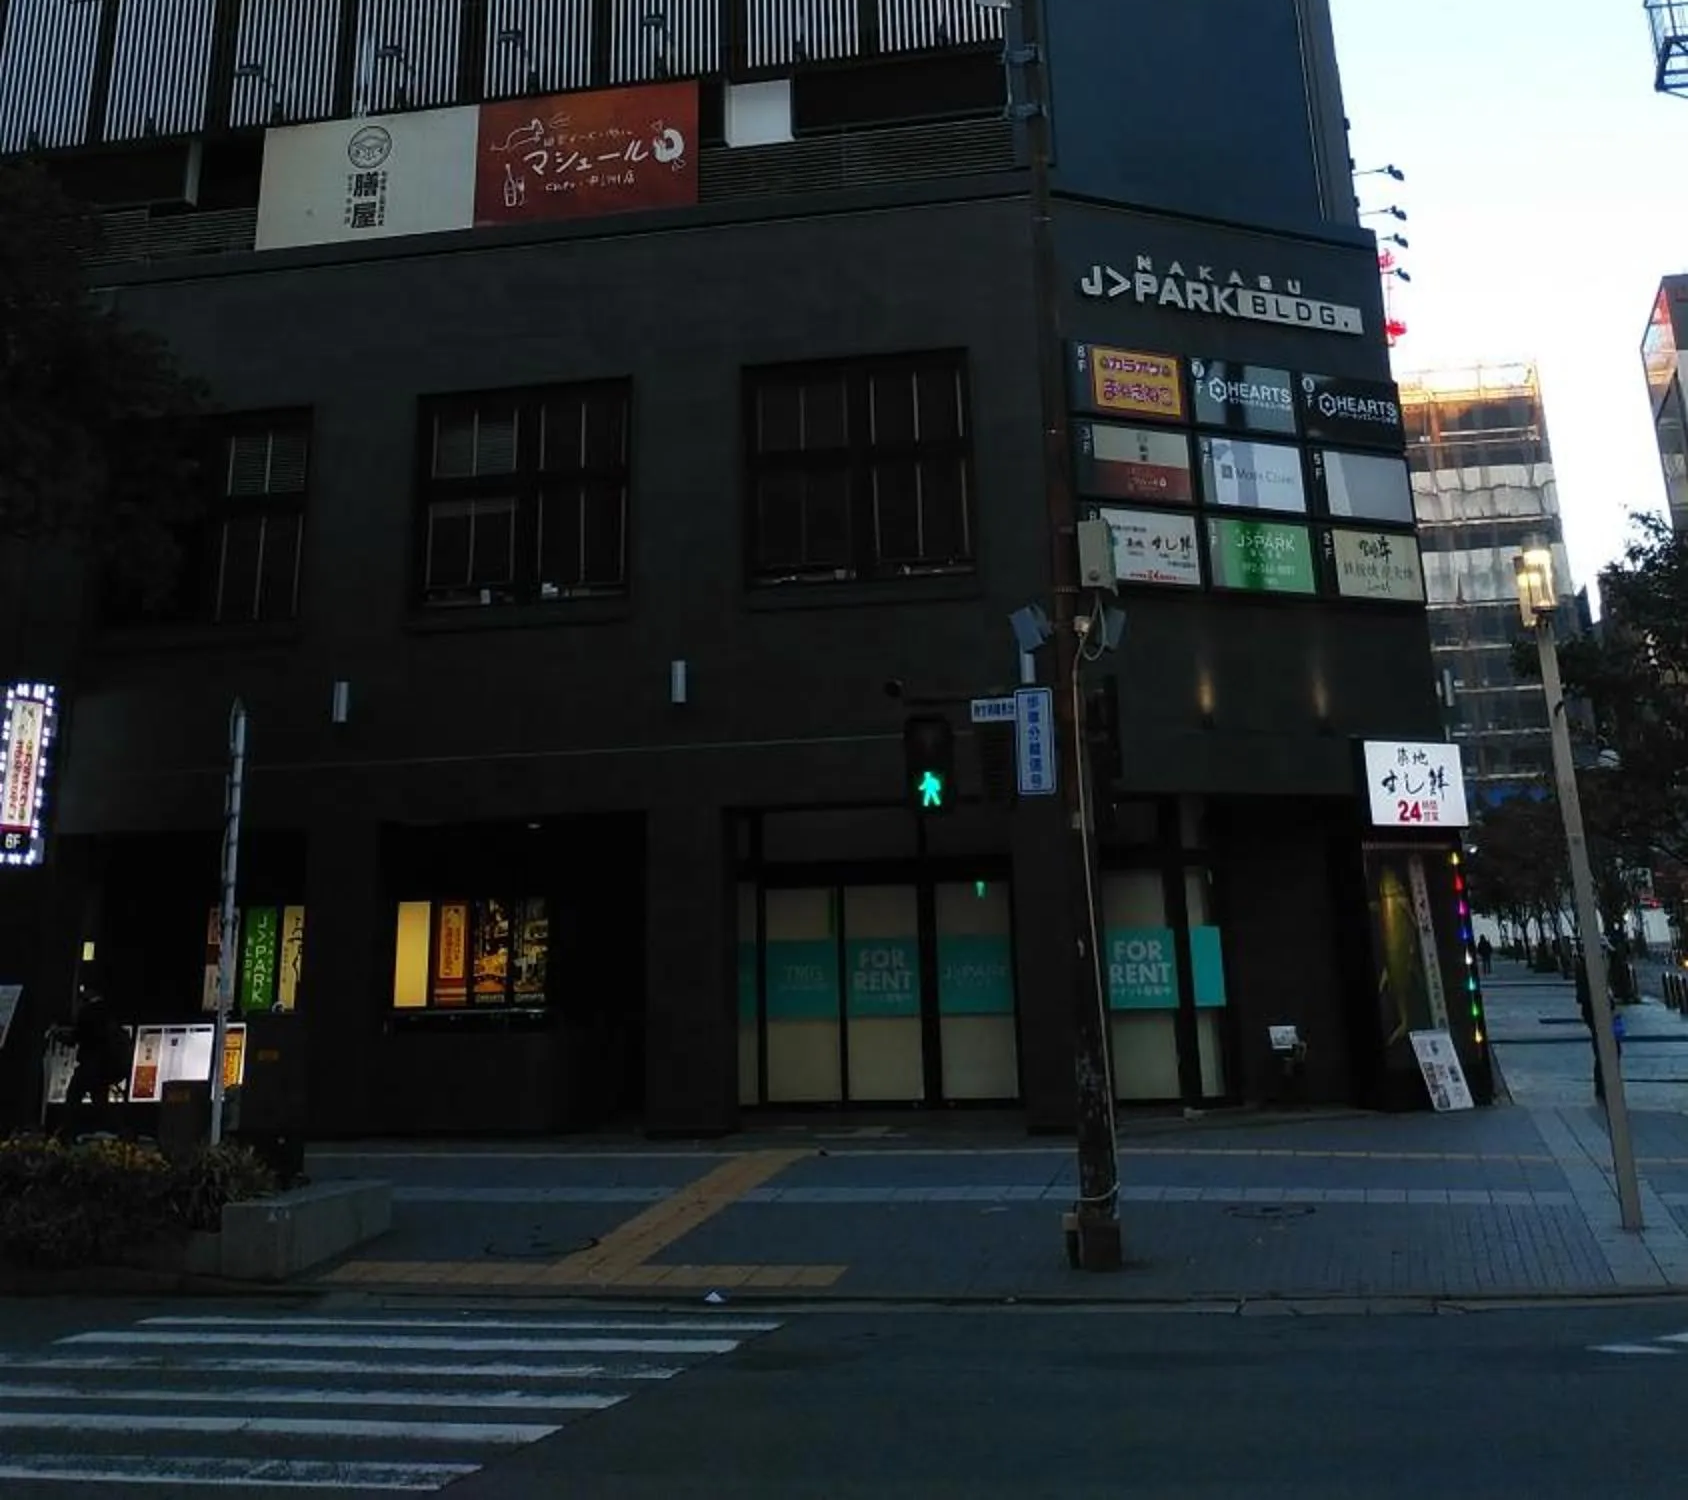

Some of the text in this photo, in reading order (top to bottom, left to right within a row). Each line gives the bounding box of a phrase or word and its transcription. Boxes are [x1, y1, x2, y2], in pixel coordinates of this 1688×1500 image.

[523, 138, 649, 177] マシュール
[1228, 381, 1292, 404] HEARTS
[1336, 395, 1397, 417] HEARTS
[1381, 766, 1450, 801] すし鮮
[1398, 799, 1422, 823] 24
[859, 948, 906, 969] FOR
[1113, 940, 1163, 962] FOR
[853, 970, 914, 992] RENT
[1109, 962, 1172, 985] RENT
